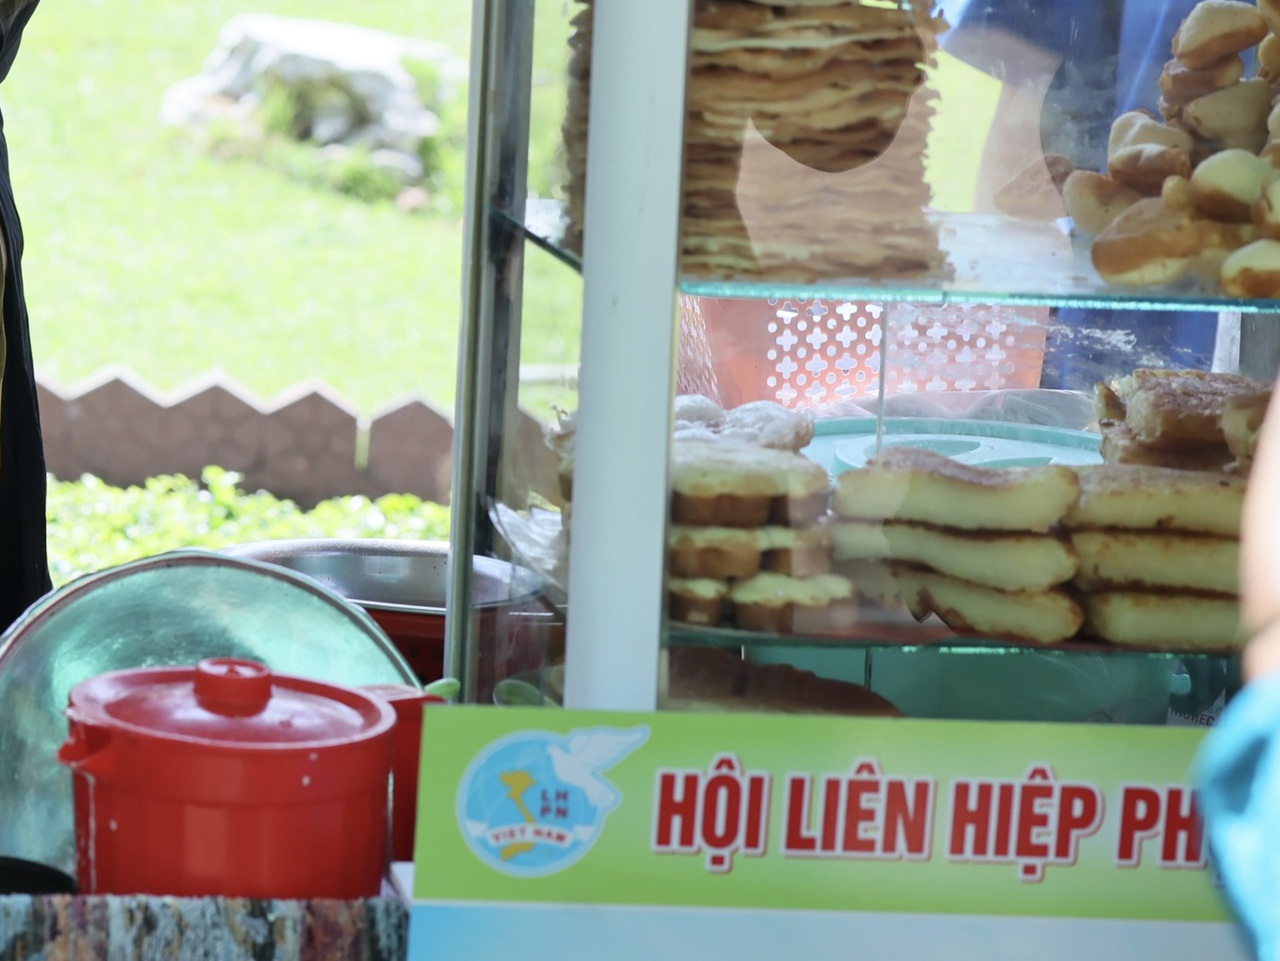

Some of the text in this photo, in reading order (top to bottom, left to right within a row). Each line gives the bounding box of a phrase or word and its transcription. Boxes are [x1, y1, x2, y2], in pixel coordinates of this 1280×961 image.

[653, 755, 1209, 877] HỘI LIÊN HIỆP PH
